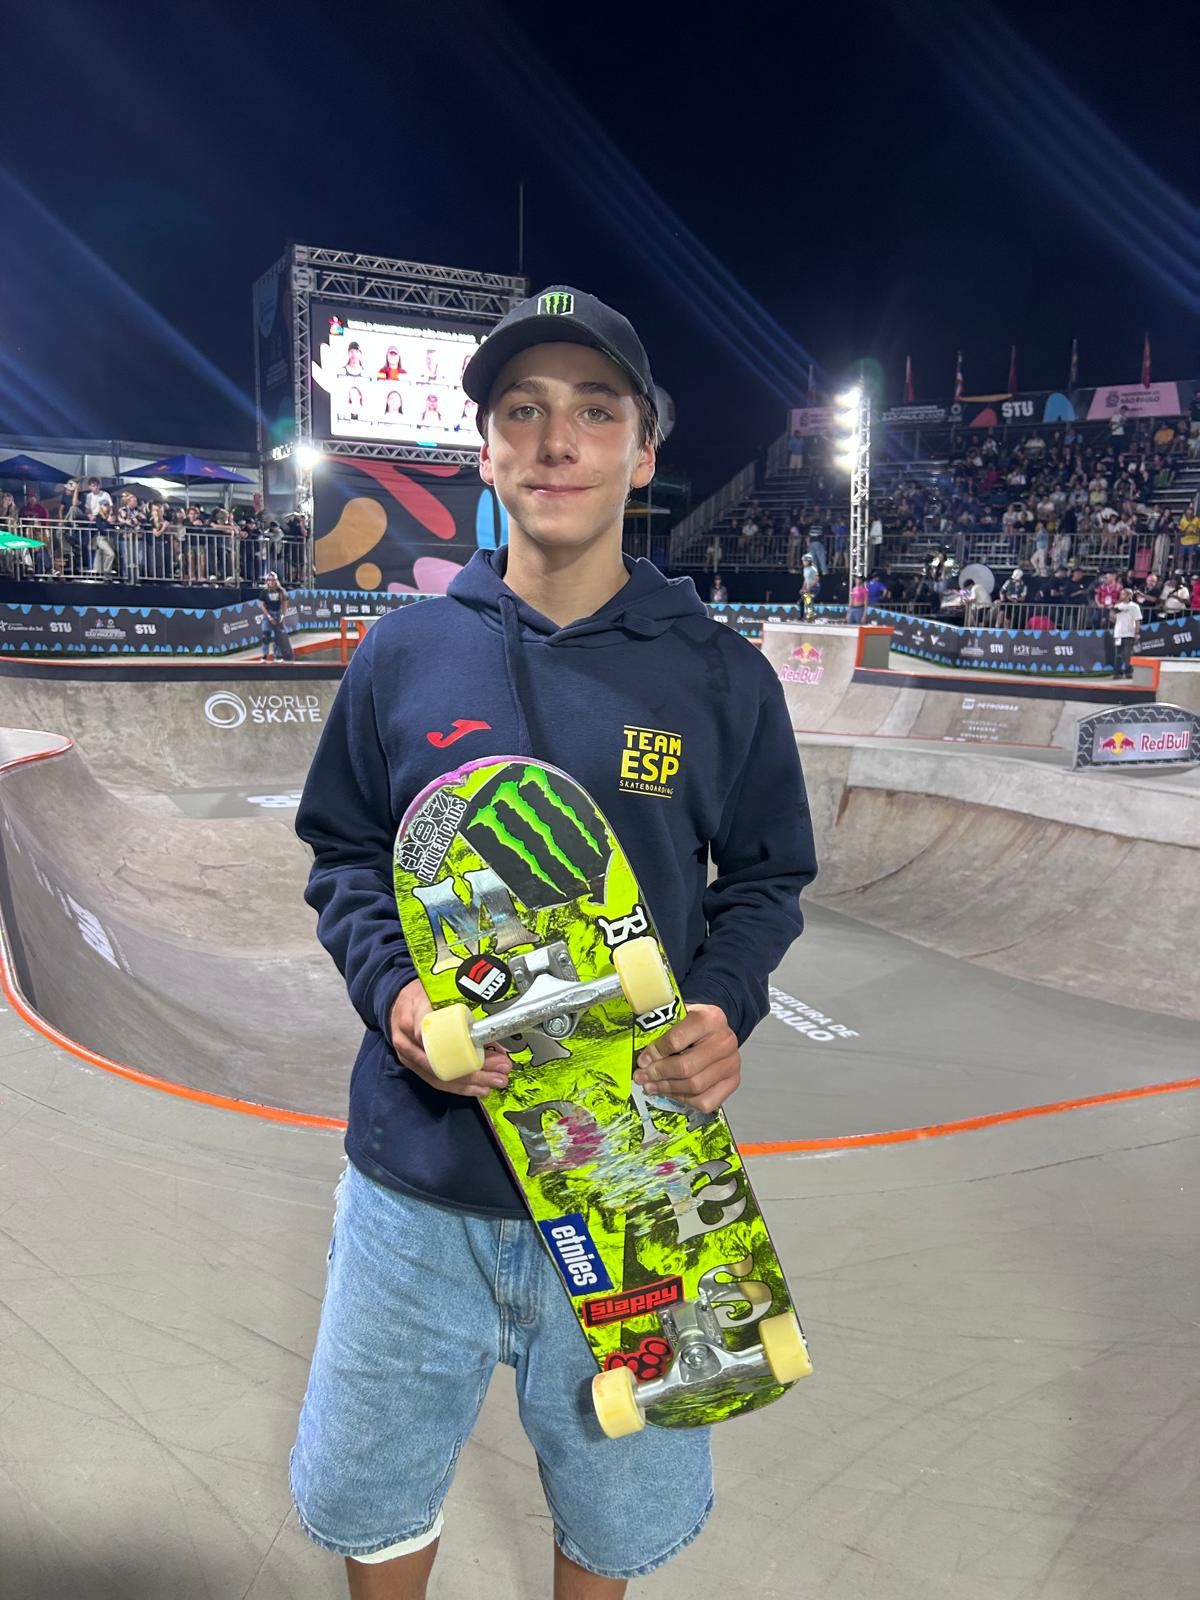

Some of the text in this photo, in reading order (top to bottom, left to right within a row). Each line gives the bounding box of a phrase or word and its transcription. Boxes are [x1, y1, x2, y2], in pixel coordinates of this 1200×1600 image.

[1001, 400, 1034, 417] STU
[50, 622, 72, 633] STU
[134, 623, 157, 635] STU
[1173, 631, 1192, 645] STU
[990, 643, 1004, 653] STU
[1054, 645, 1074, 656] STU
[249, 694, 319, 709] WORLD
[251, 708, 323, 724] SKATE
[623, 729, 682, 757] TEAM
[1140, 730, 1190, 753] Red Bull
[620, 749, 680, 785] ESP
[619, 779, 675, 796] SKATEBOARDING
[416, 797, 467, 883] KILLER PADS
[770, 1001, 835, 1041] PAULO
[827, 1023, 860, 1039] DE
[551, 1224, 598, 1287] etnies
